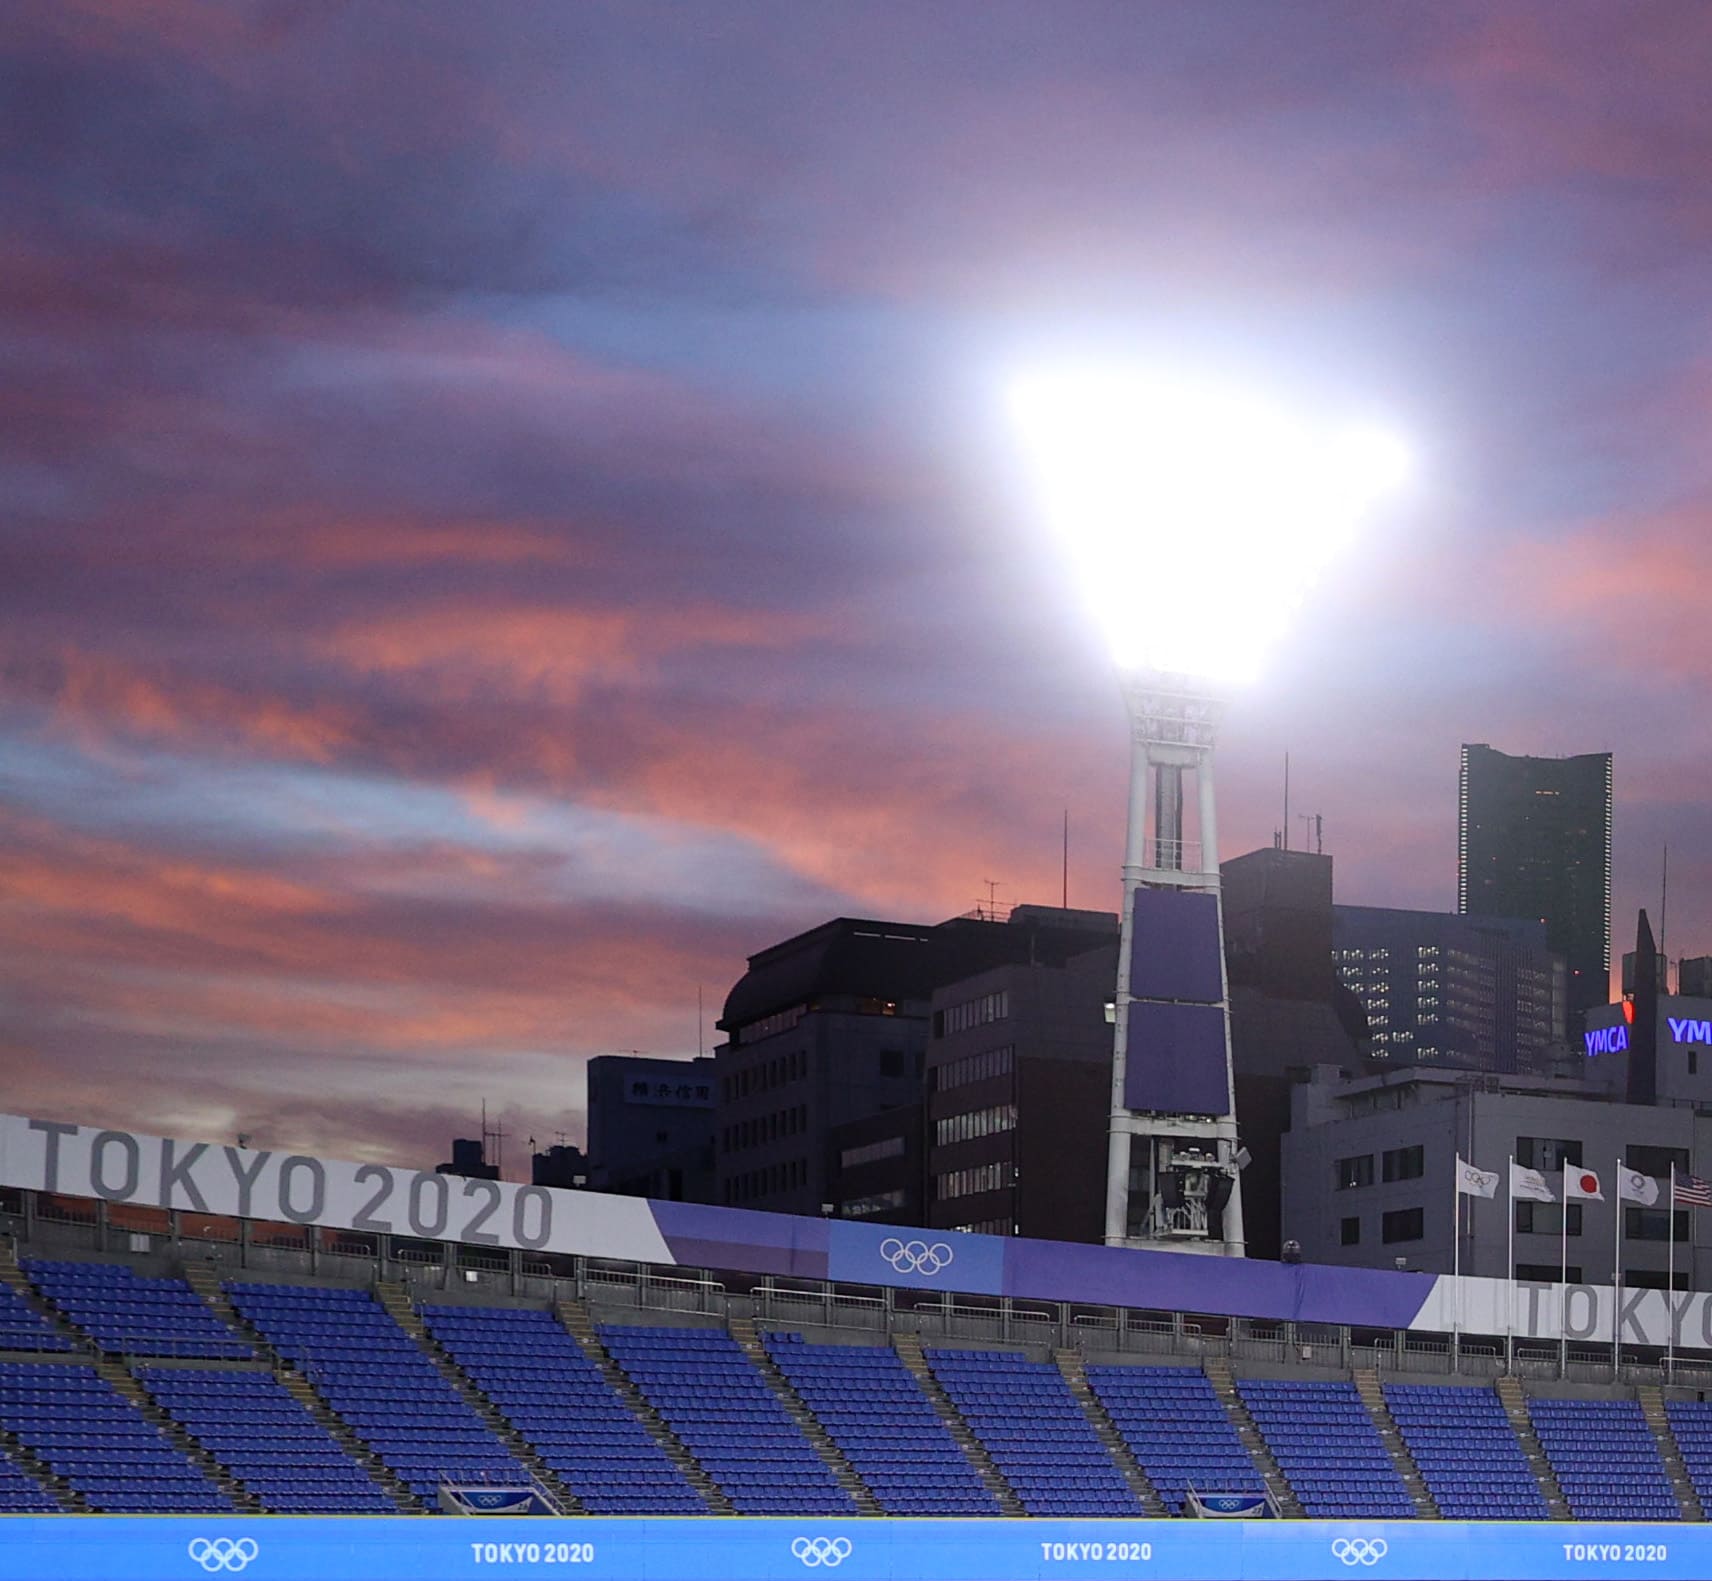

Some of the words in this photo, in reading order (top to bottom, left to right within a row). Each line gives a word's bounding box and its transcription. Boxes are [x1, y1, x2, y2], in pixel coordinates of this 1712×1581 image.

[1584, 1025, 1628, 1057] YMCA
[28, 1118, 326, 1224] TOKYO
[351, 1165, 554, 1249] 2020
[472, 1544, 540, 1562] TOKYO
[544, 1544, 593, 1562] 2020
[1041, 1543, 1103, 1560] TOKYO
[1107, 1543, 1151, 1560] 2020
[1563, 1545, 1620, 1560] TOKYO
[1625, 1545, 1666, 1561] 2020
